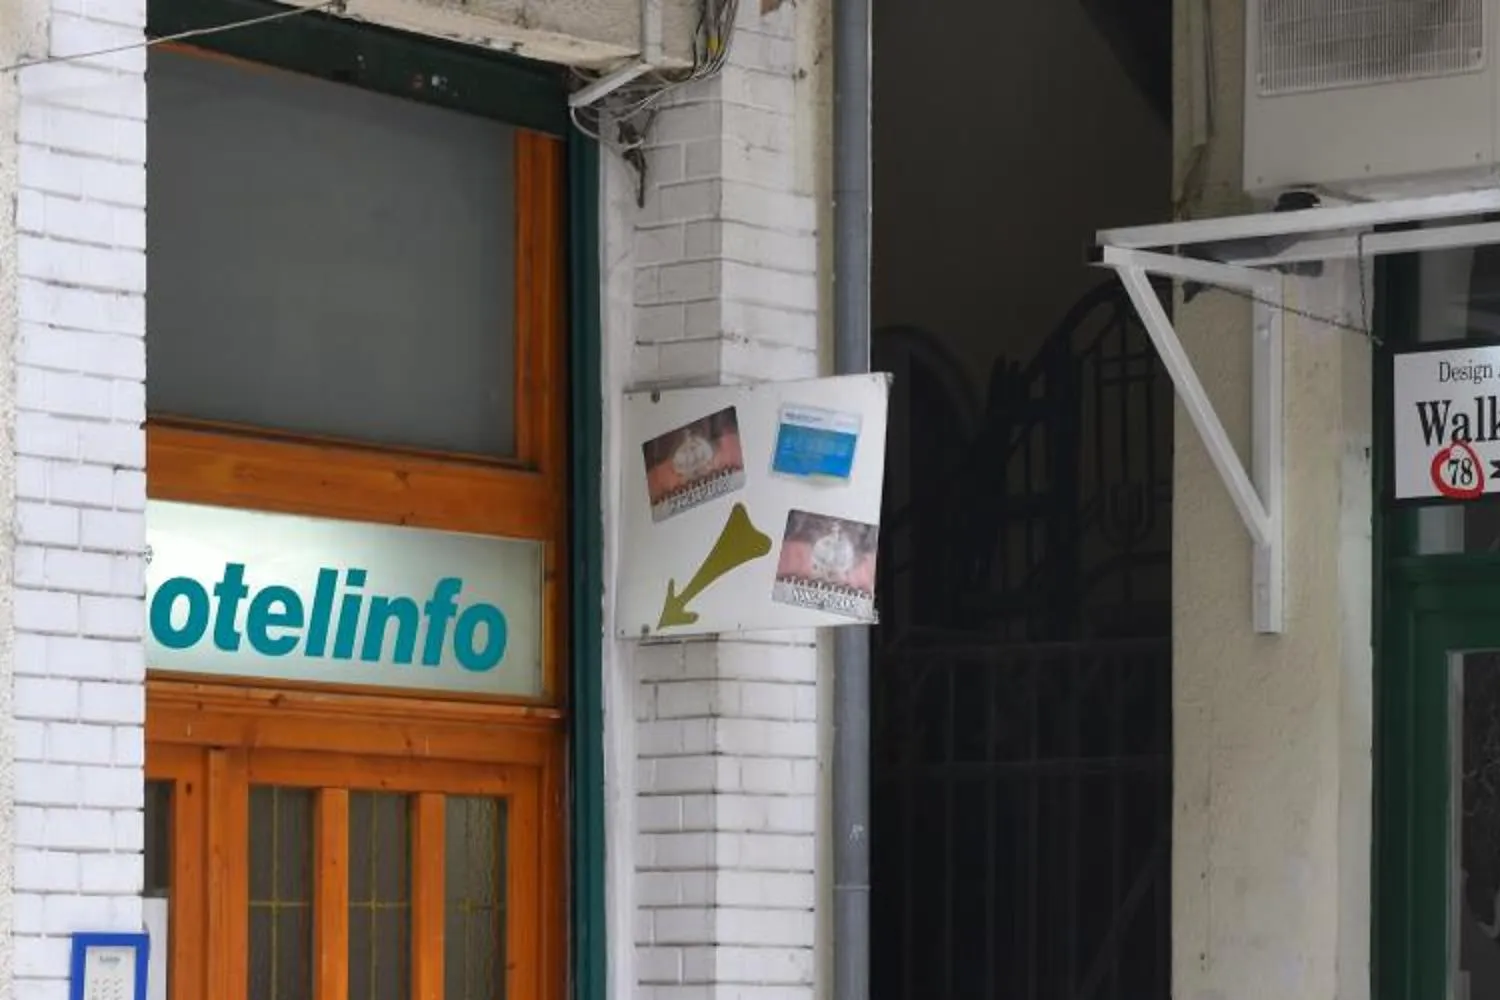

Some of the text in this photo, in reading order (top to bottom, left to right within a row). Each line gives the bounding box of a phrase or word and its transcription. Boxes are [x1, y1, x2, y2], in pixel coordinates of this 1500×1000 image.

[1438, 360, 1493, 385] Design
[1447, 457, 1473, 486] 78
[149, 561, 508, 674] otelinfo
